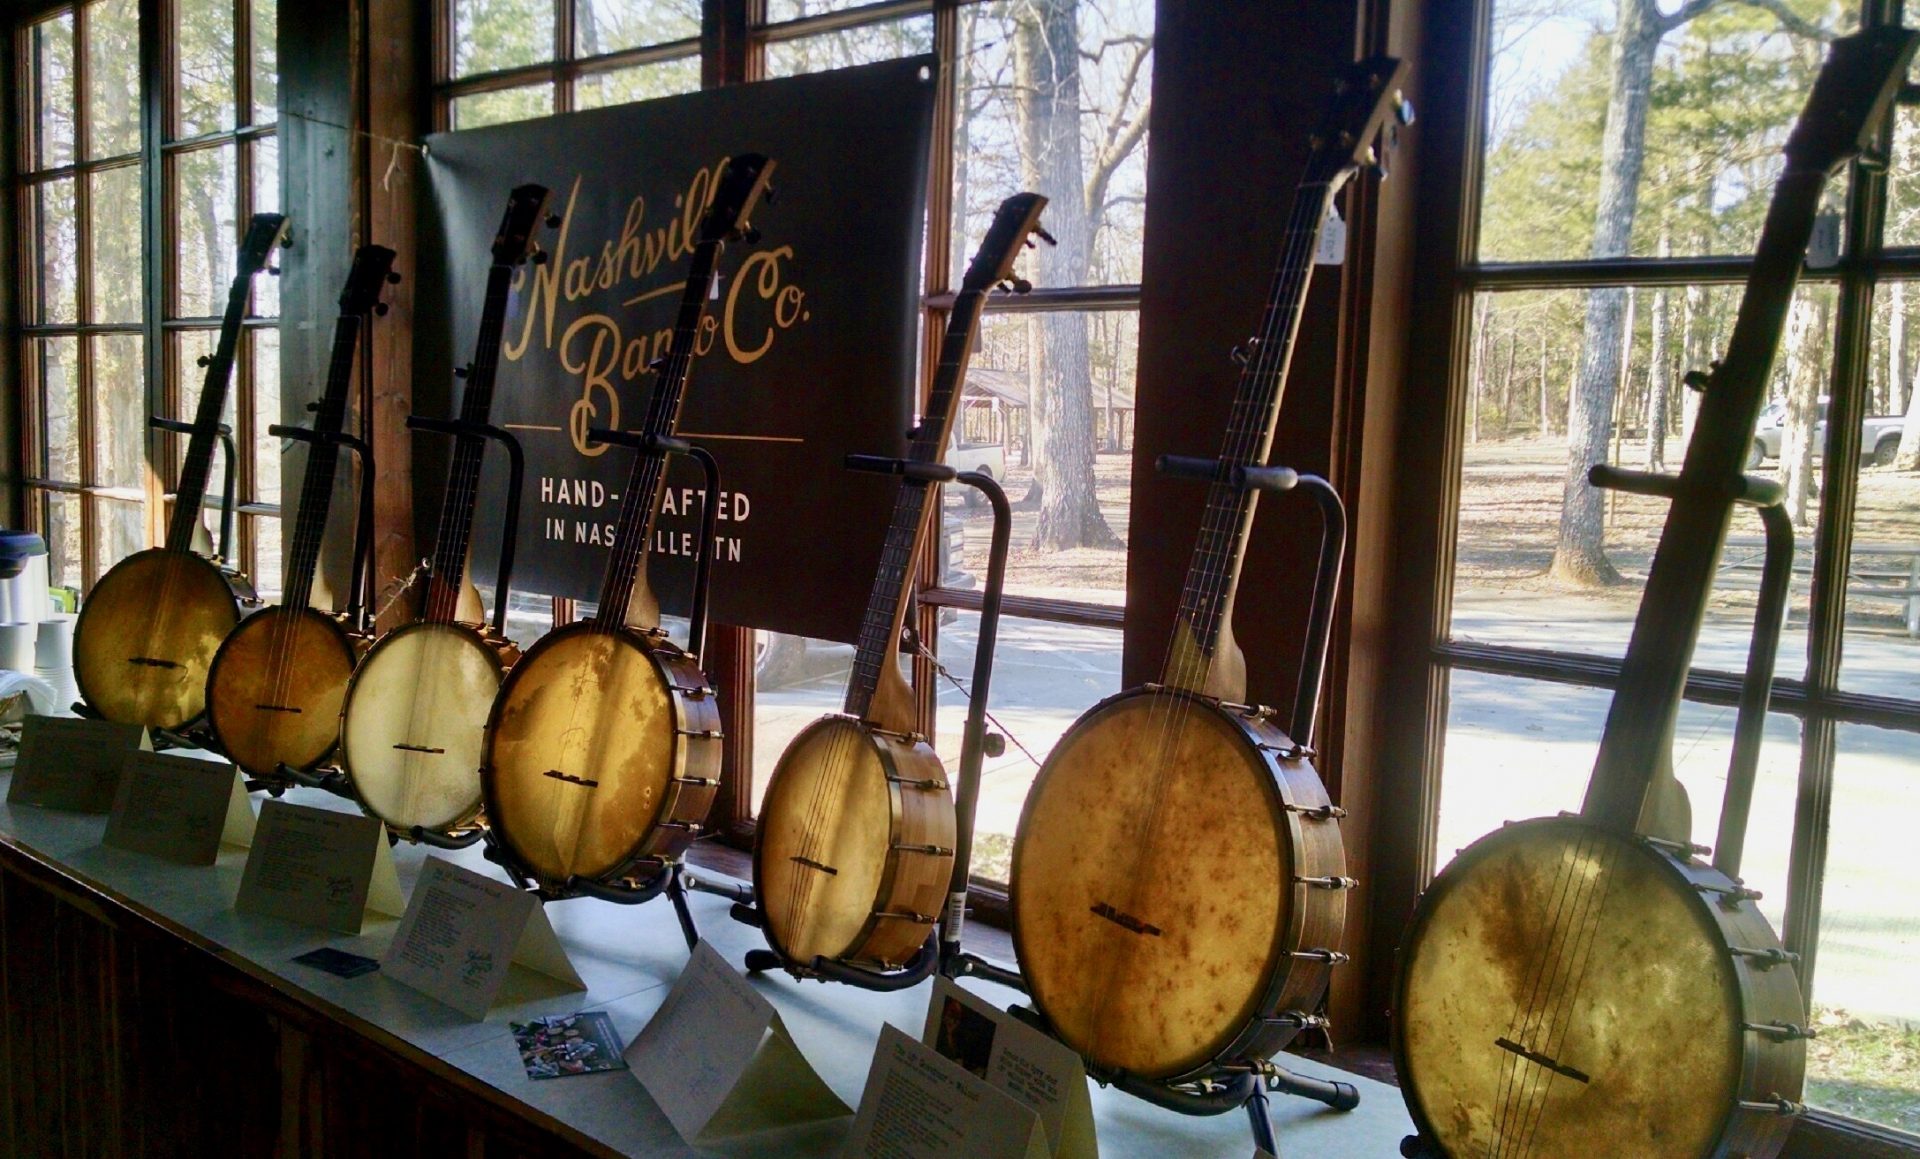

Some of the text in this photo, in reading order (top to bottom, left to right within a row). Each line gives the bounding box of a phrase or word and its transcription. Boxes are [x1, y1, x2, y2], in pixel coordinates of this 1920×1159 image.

[503, 155, 732, 363] Nashvil
[559, 243, 811, 458] Bano Co.
[541, 476, 751, 522] HAND-AFTED
[545, 517, 741, 563] IN NASLLE, TN
